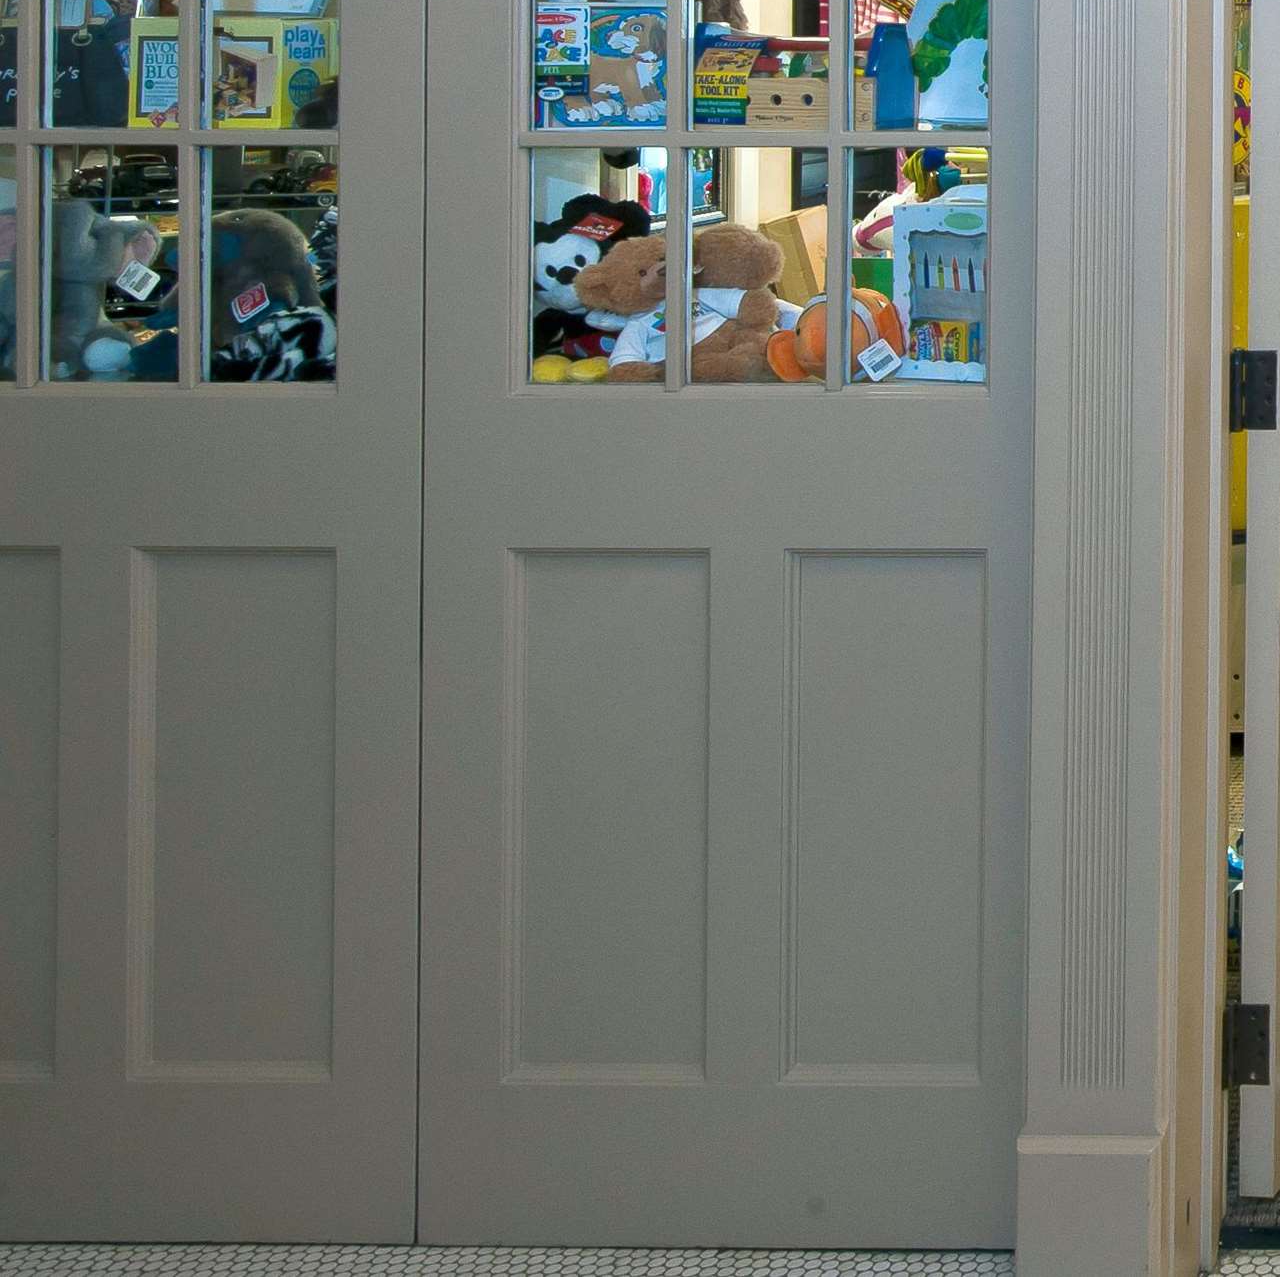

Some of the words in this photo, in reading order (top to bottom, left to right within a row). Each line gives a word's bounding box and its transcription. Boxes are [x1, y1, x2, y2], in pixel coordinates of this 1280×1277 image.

[288, 43, 325, 59] learn
[700, 85, 721, 96] TOOL
[723, 85, 740, 96] KIT
